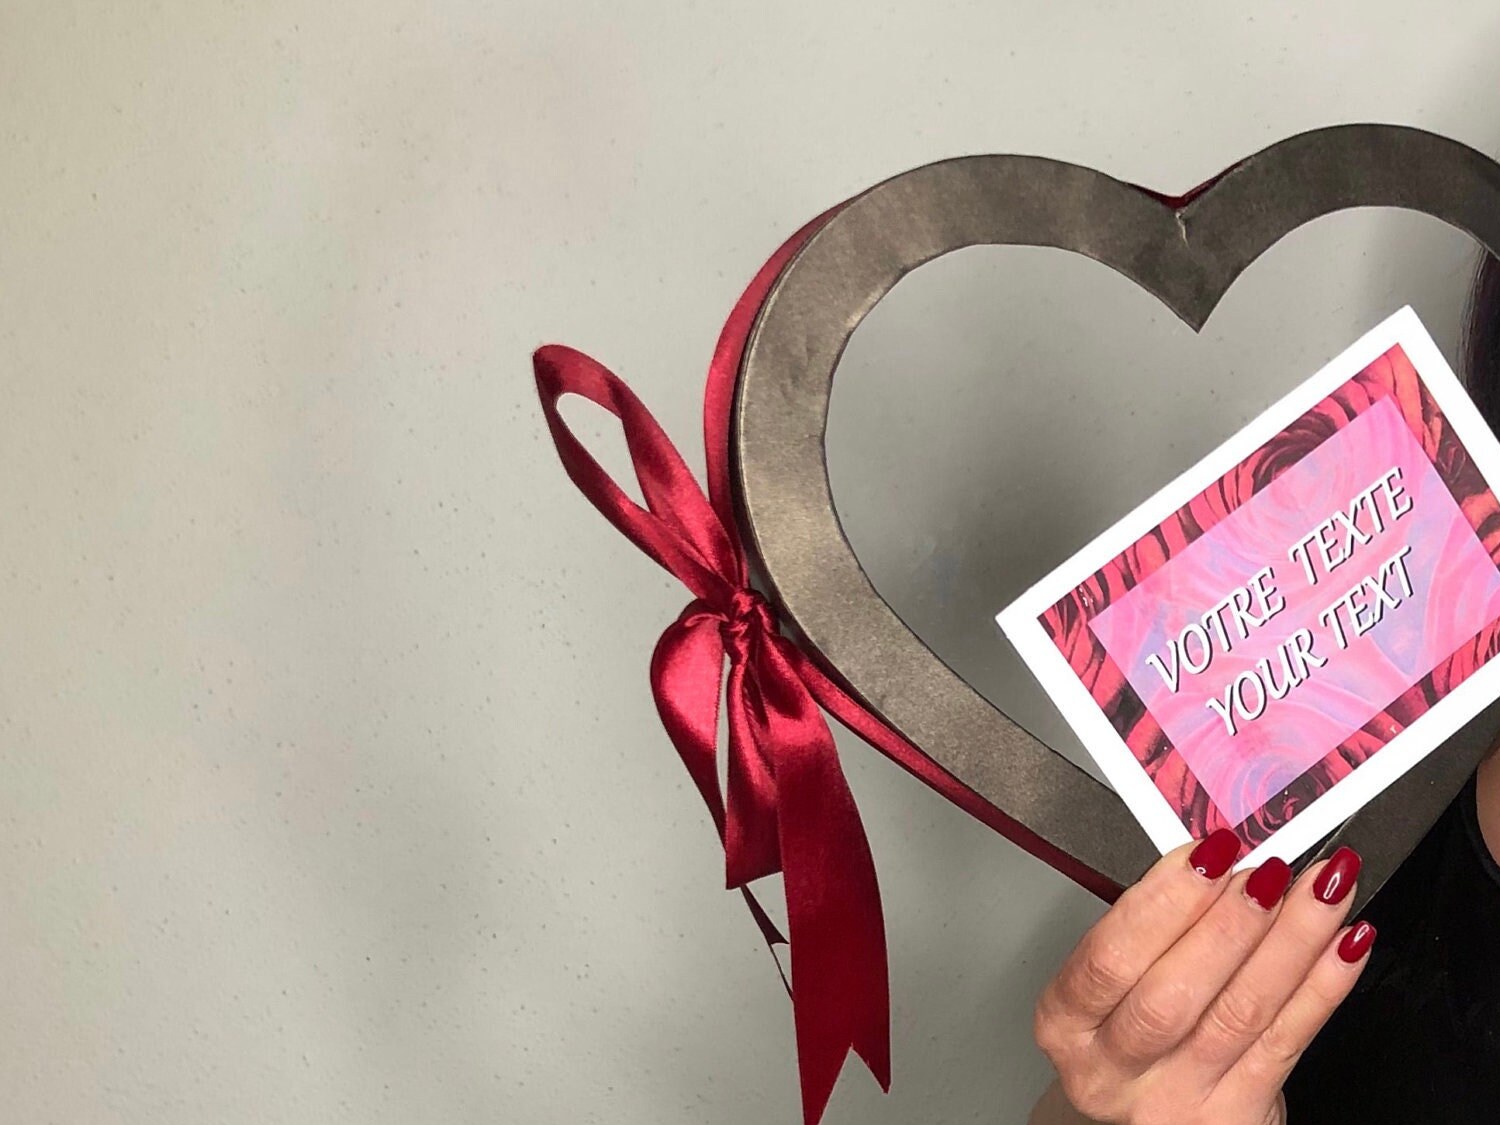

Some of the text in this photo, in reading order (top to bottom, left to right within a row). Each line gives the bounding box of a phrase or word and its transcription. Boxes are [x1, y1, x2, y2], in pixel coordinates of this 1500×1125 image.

[1145, 466, 1415, 693] VOTRE TEXTE
[1206, 546, 1416, 737] YOUR TEXT
